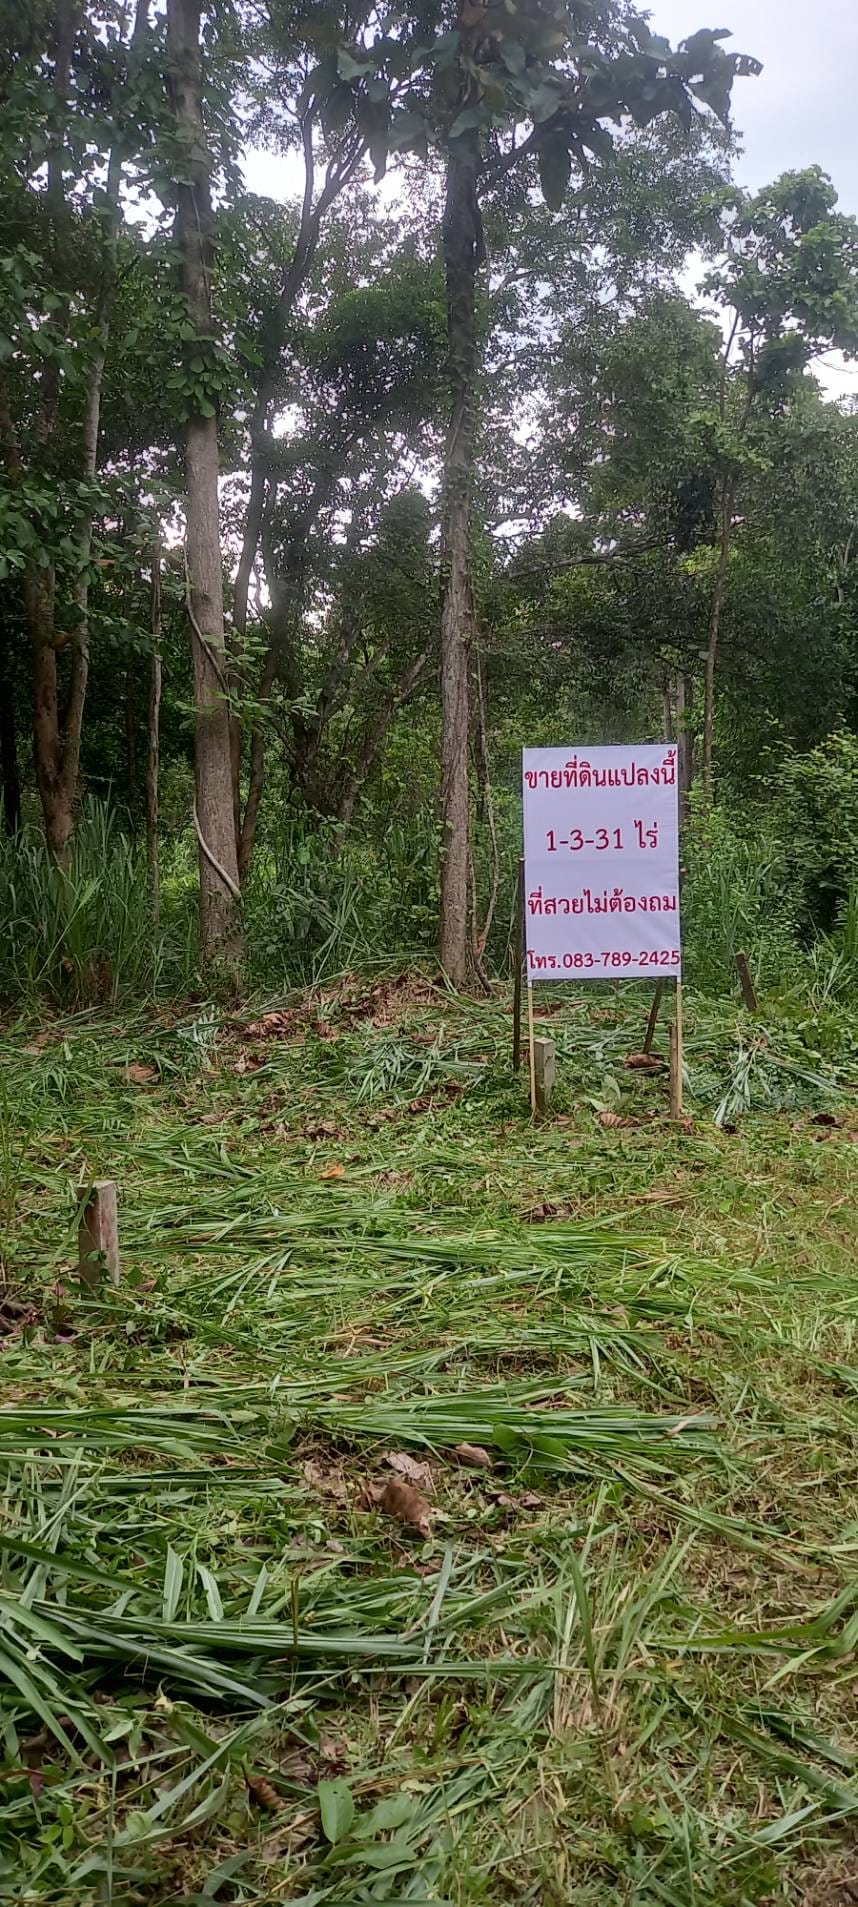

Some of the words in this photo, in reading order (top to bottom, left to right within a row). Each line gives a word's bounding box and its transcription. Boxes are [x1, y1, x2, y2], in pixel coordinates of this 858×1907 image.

[524, 750, 676, 789] ขายที่ดินแปลงนี้
[546, 828, 624, 852] 1-3-31
[634, 819, 658, 850] ไร่
[528, 886, 676, 916] ที่สวยไม่ต้องถม
[527, 950, 680, 969] โทร.083-789-2425
